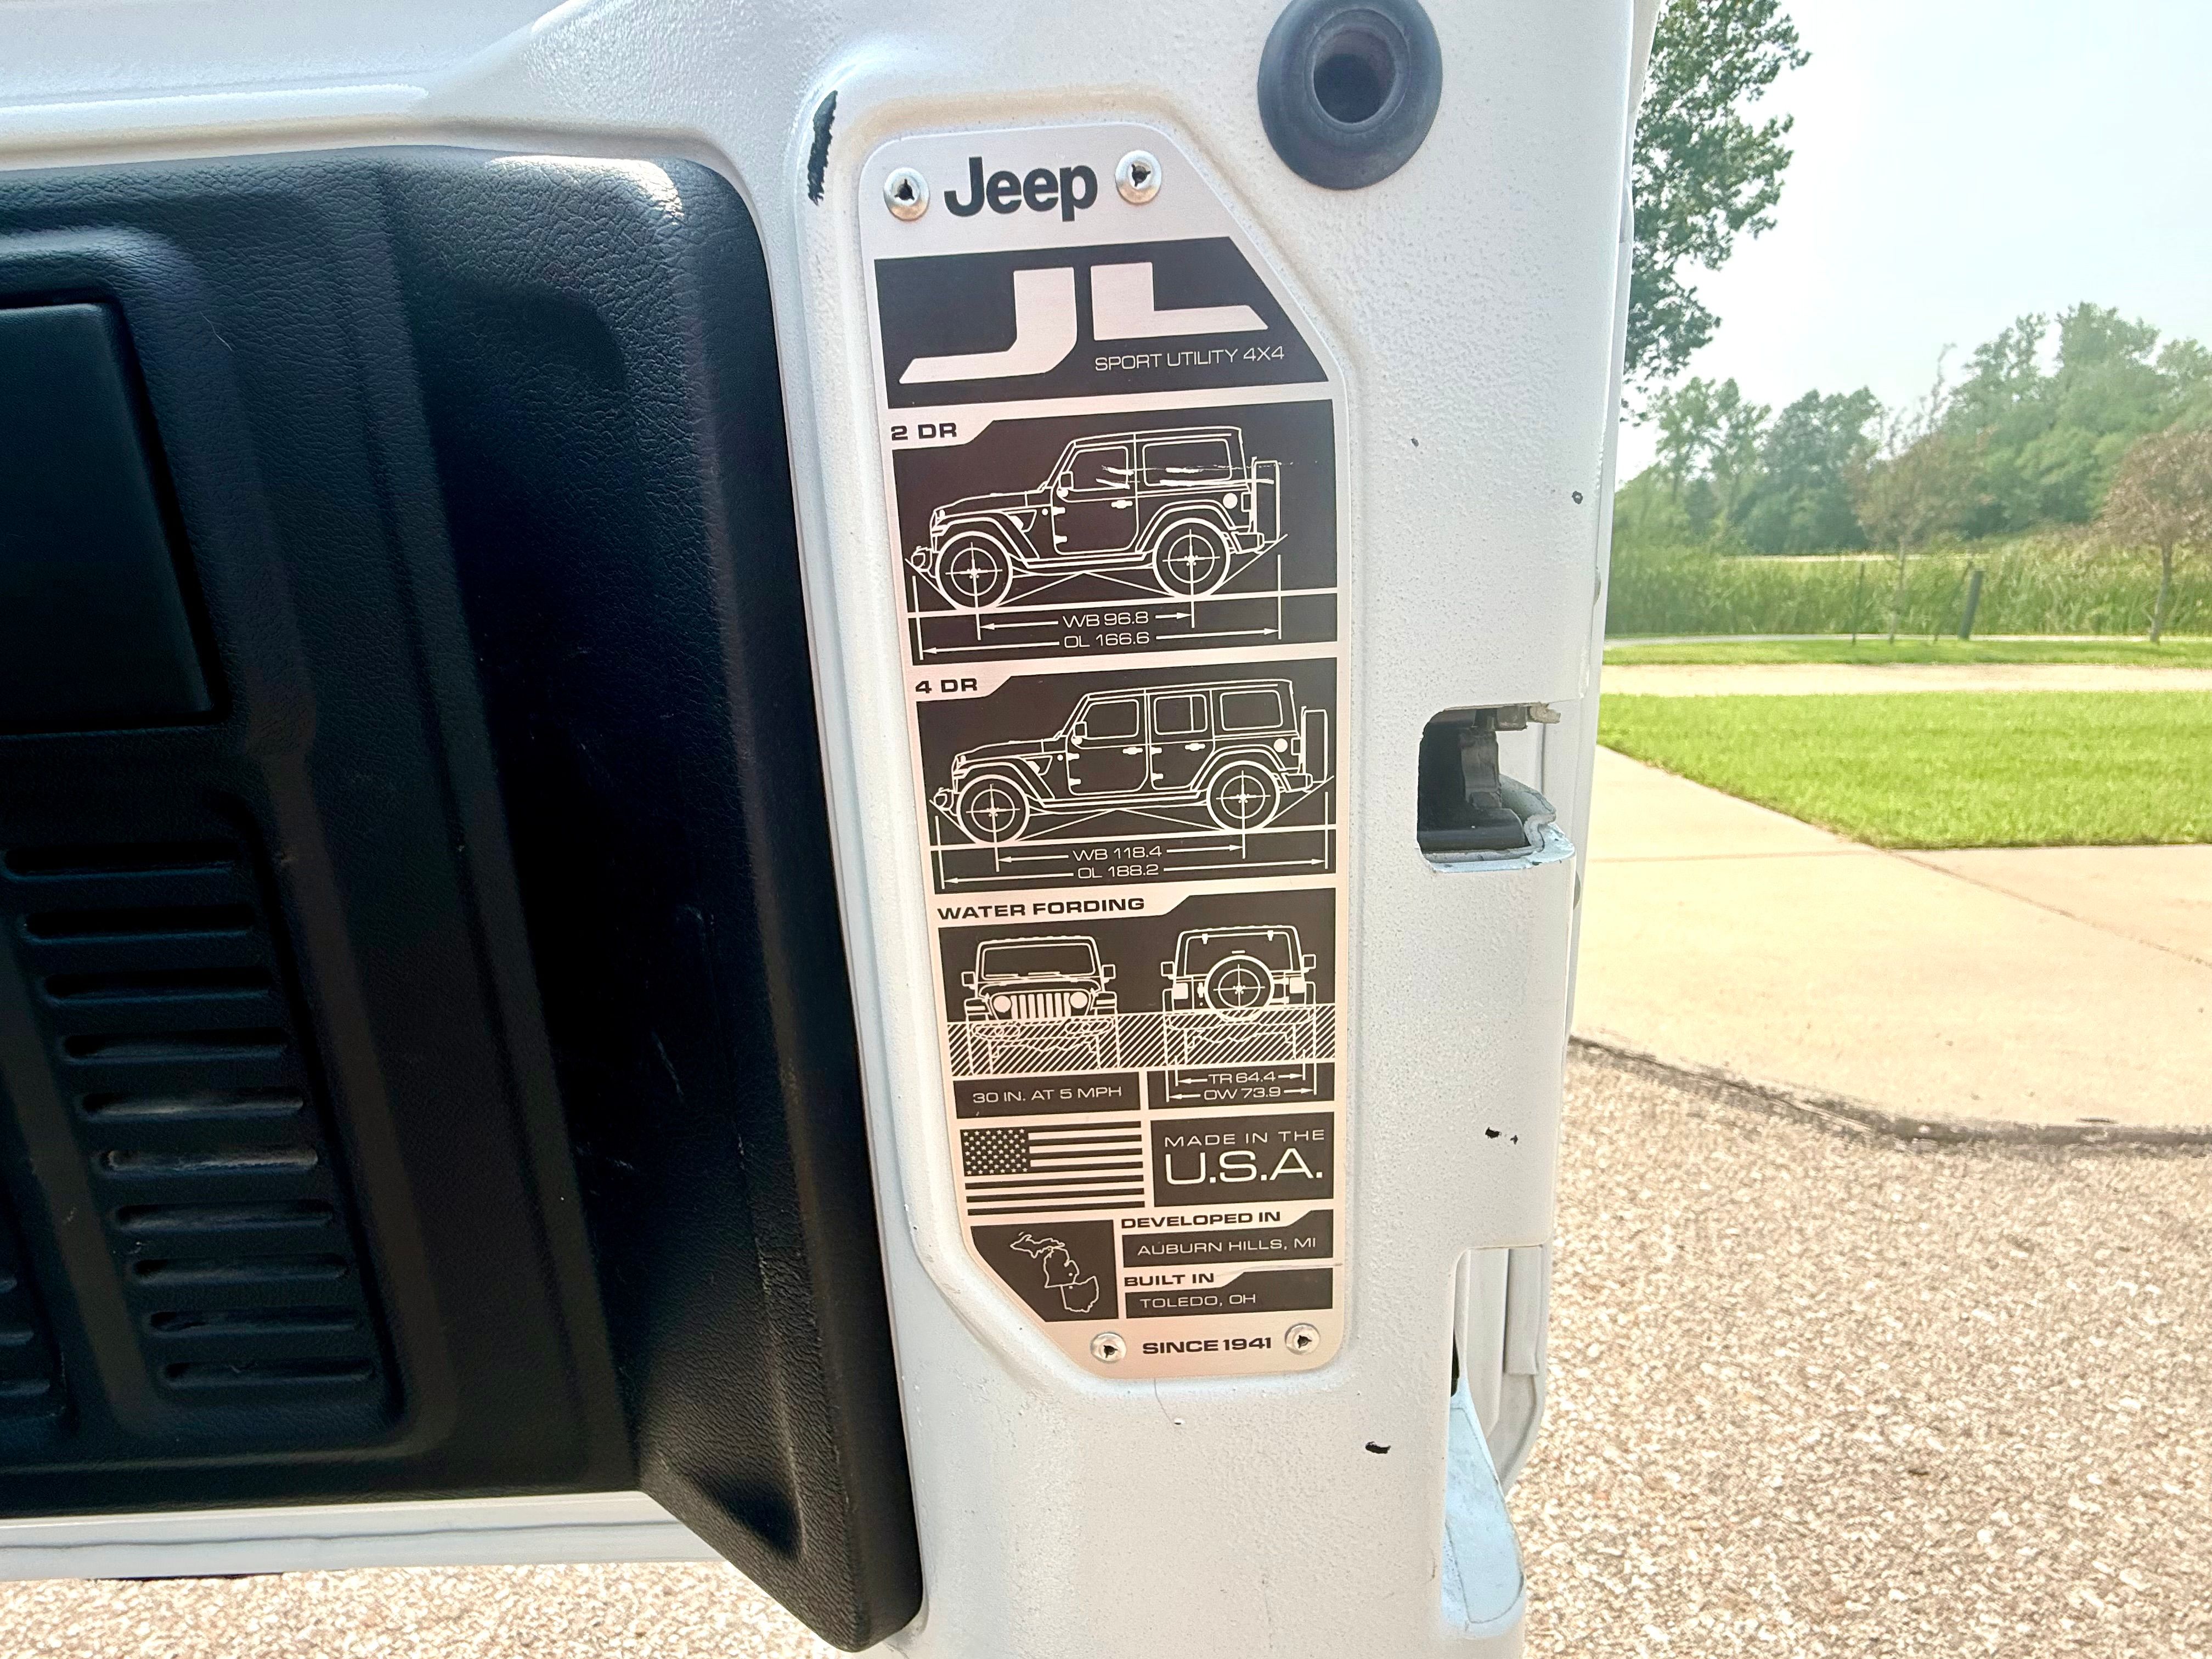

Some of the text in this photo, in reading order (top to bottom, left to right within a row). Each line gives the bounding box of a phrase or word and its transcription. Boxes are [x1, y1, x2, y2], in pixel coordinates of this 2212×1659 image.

[944, 156, 1098, 222] Jeep
[899, 262, 1268, 384] JL
[1094, 346, 1285, 371] SPORT UTILITY 4X4
[891, 423, 957, 440] 2 DR
[1063, 611, 1149, 627] WB 96.8
[1064, 631, 1150, 648] OL 166.6
[915, 679, 978, 694] 4 DR
[1072, 845, 1163, 861] WB 118.4
[1077, 864, 1159, 879] OL 188.2
[937, 898, 1145, 921] WATER FORDING
[1208, 1071, 1275, 1085] TR 64.4
[972, 1086, 1121, 1104] 30 IN. AT 5 MPH
[1204, 1087, 1281, 1100] OW 73.9
[1164, 1129, 1324, 1147] MADE IN THE
[1165, 1148, 1323, 1186] U.S.A.
[1121, 1211, 1280, 1228] DEVELOPED IN
[1137, 1237, 1316, 1256] AUBURN HILLS, MI
[1124, 1273, 1214, 1286] BUILT IN
[1140, 1294, 1256, 1308] TOLEDO, OH
[1142, 1338, 1272, 1355] SINCE 1941
